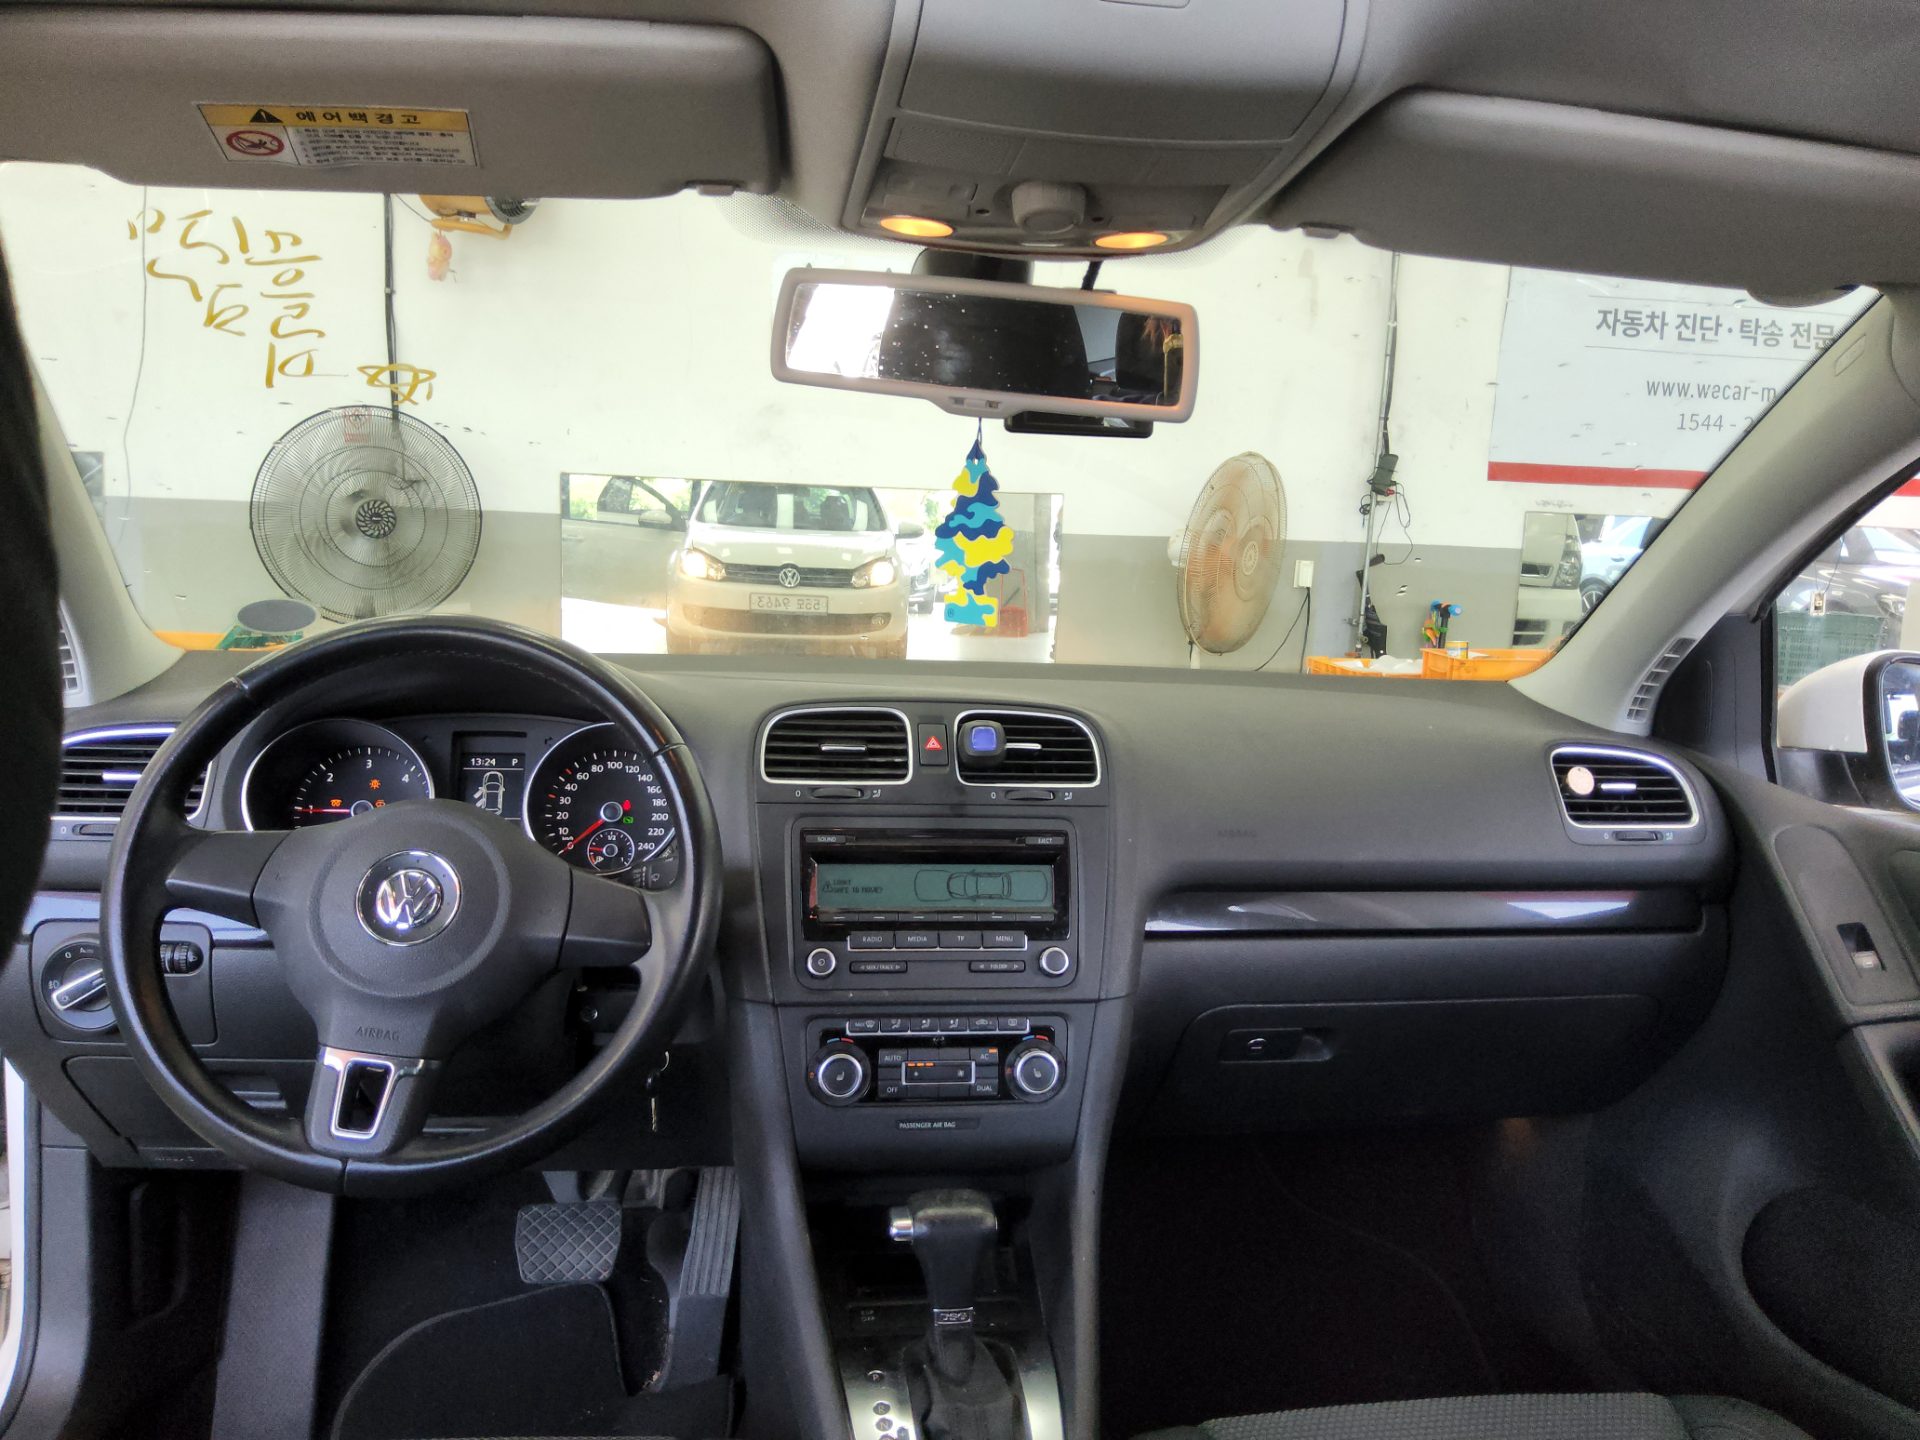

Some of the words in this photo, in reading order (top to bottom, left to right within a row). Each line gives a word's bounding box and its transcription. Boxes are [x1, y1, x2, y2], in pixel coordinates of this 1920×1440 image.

[1595, 308, 1670, 340] 자동차
[1789, 321, 1837, 351] 전문
[365, 758, 373, 770] 3
[470, 757, 497, 767] 13:24
[511, 758, 519, 767] P
[607, 761, 623, 769] 100
[590, 764, 604, 773] 80
[625, 765, 640, 774] 120
[326, 772, 335, 784] 2
[401, 773, 410, 784] 4
[576, 772, 590, 781] 60
[637, 773, 653, 782] 140
[564, 783, 578, 792] 40
[647, 785, 662, 794] 160
[559, 796, 572, 805] 30
[652, 798, 668, 807] 180
[556, 811, 570, 820] 20
[651, 812, 669, 821] 200
[558, 826, 570, 836] 10
[647, 827, 665, 836] 220
[637, 842, 656, 851] 240
[862, 935, 884, 943] RADIO
[907, 935, 928, 943] MEDIA
[995, 935, 1014, 943] MENU
[355, 1025, 400, 1041] AIRBAG
[884, 1054, 902, 1062] AUTO
[980, 1053, 990, 1061] AC
[886, 1086, 899, 1094] OFF
[976, 1084, 993, 1092] DUAL
